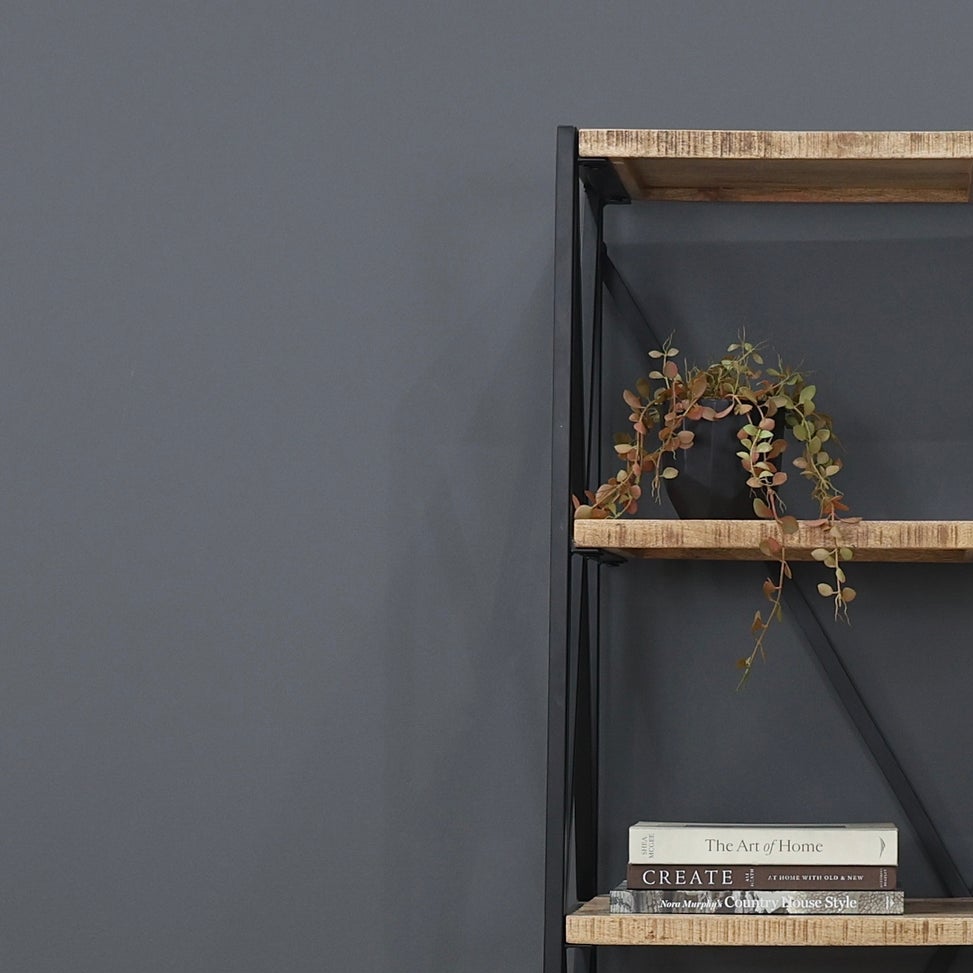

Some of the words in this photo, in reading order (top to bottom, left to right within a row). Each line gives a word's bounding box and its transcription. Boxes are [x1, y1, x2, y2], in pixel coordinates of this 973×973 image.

[705, 838, 734, 852] The
[736, 839, 760, 852] Art
[763, 839, 777, 856] of
[779, 839, 823, 853] Home
[642, 869, 733, 885] CREATE
[660, 899, 681, 908] Nora
[724, 895, 778, 911] Country
[781, 895, 822, 909] House
[824, 895, 857, 911] Style
